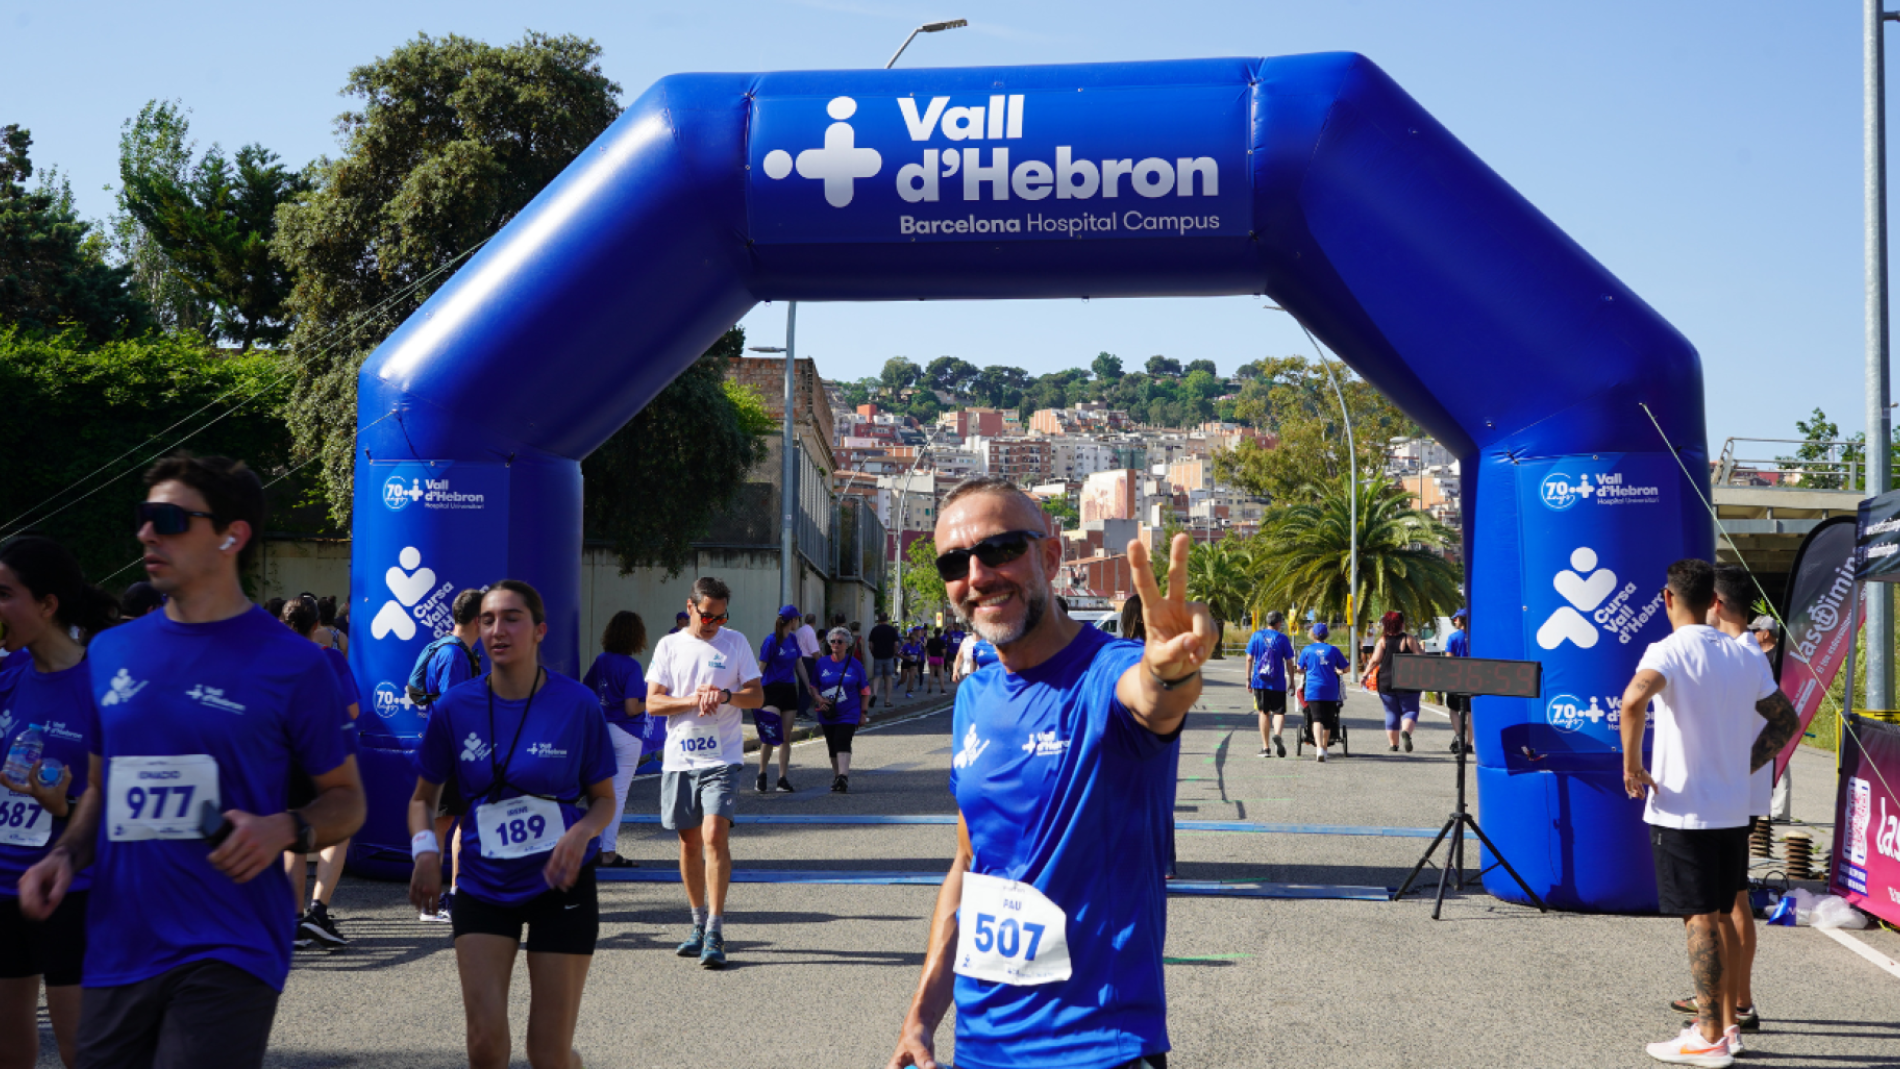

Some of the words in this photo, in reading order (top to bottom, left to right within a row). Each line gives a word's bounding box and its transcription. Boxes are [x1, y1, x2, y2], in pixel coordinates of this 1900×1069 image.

[897, 94, 1024, 141] Vall
[896, 145, 1218, 203] d'Hebron
[900, 214, 1020, 235] Barcelona
[1027, 211, 1116, 237] Hospital
[1123, 210, 1220, 236] Campus
[425, 479, 449, 490] Vall
[1546, 481, 1568, 496] 70
[1595, 473, 1623, 485] Vall
[387, 484, 403, 497] 70
[424, 491, 484, 502] d'Hebron
[1596, 484, 1658, 497] d'Hebron
[413, 581, 454, 619] Cursa
[1594, 581, 1637, 624] Cursa
[420, 602, 449, 628] Vall
[1602, 604, 1635, 633] Vall
[377, 691, 393, 705] 70
[1552, 704, 1576, 719] 70
[680, 736, 717, 752] 1026
[126, 785, 196, 819] 977
[496, 814, 545, 846] 189
[1003, 899, 1022, 911] PAU
[974, 912, 1046, 961] 507
